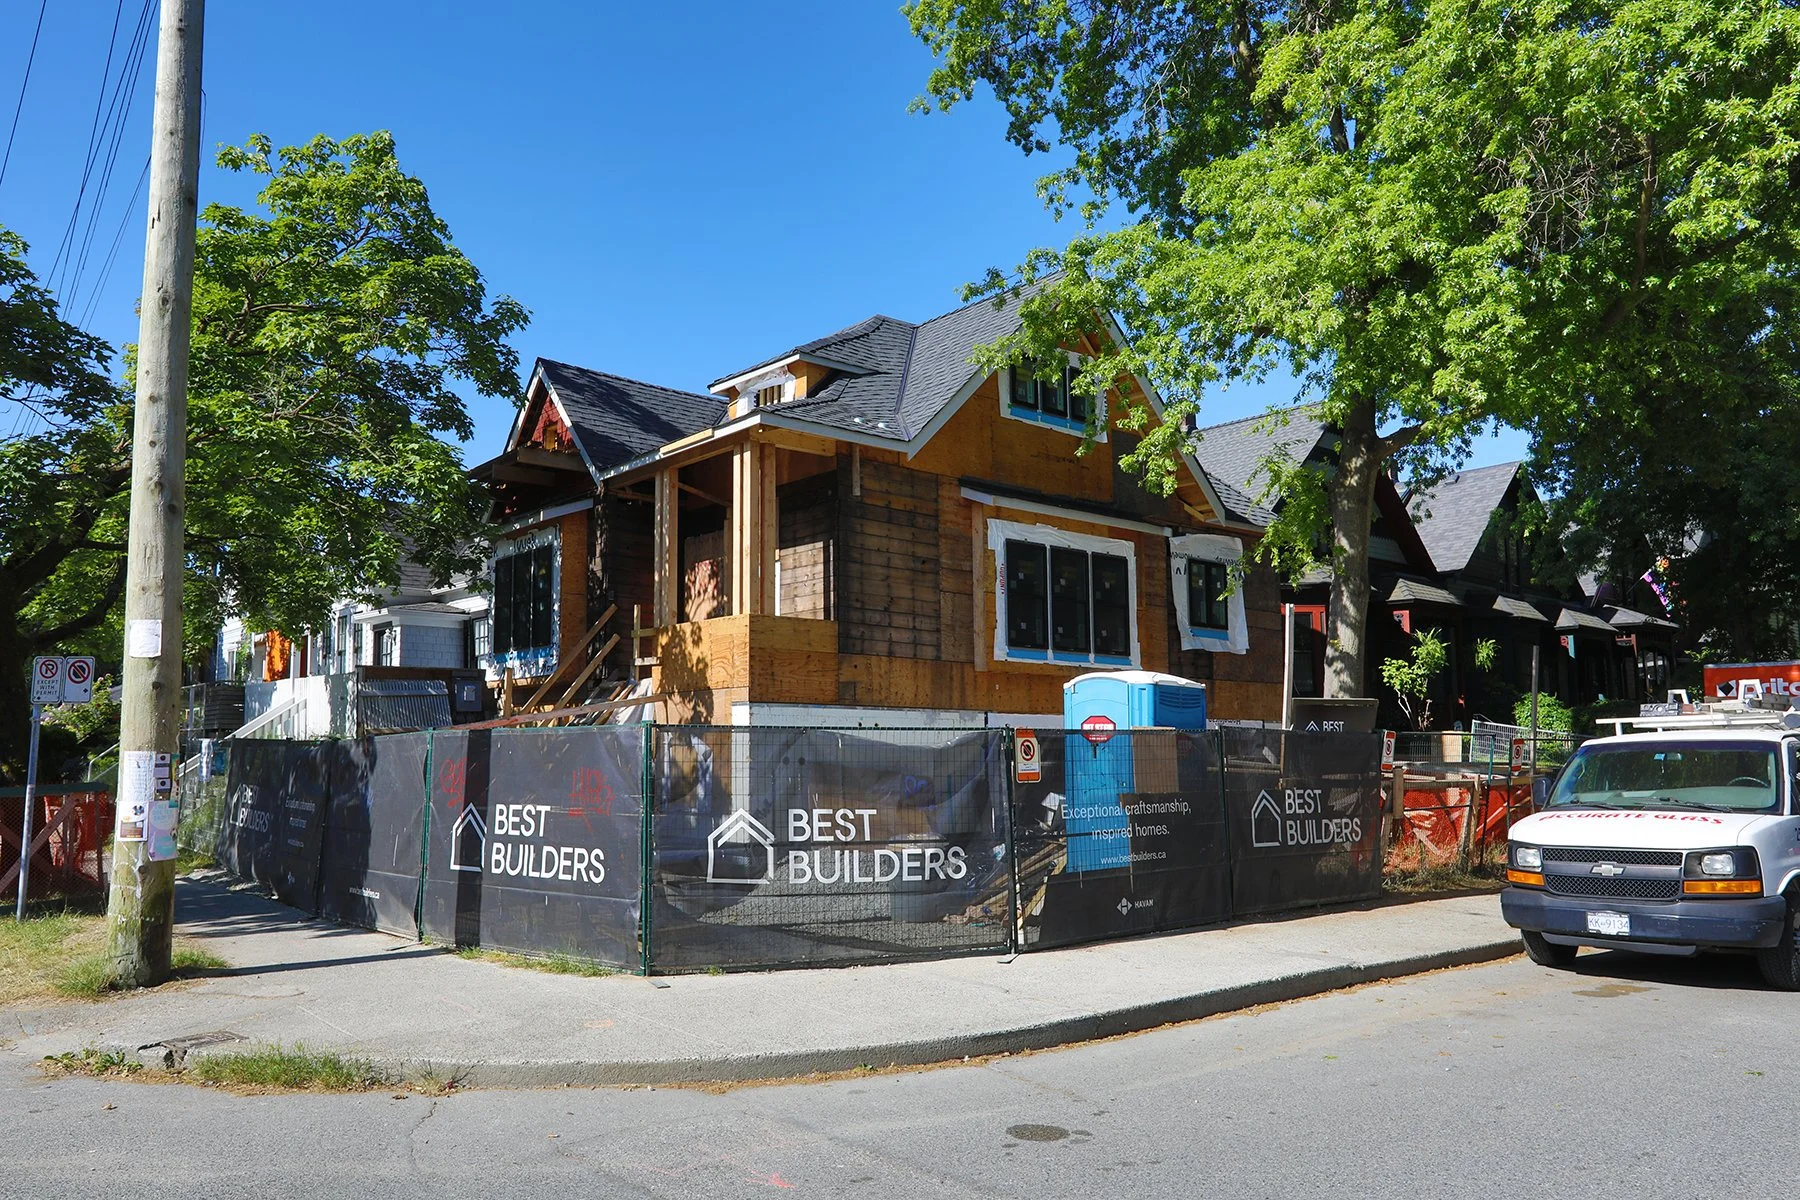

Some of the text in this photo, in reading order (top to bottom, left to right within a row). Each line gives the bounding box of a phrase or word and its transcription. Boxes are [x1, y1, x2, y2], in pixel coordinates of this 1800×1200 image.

[1323, 720, 1344, 732] BEST
[1061, 798, 1192, 821] Exceptional craftsmanship,
[1285, 789, 1322, 815] BEST
[239, 807, 270, 833] BUILDERS
[494, 804, 551, 838] BEST
[788, 808, 878, 842] BEST
[1286, 817, 1362, 846] BUILDERS
[1539, 813, 1724, 824] ACCURATE GLASS
[1091, 822, 1170, 843] inspired homes.
[491, 842, 606, 884] BUILDERS
[789, 846, 968, 884] BUILDERS
[1100, 850, 1167, 865] www.bestbuilders.ca
[1134, 898, 1154, 909] HAVAN
